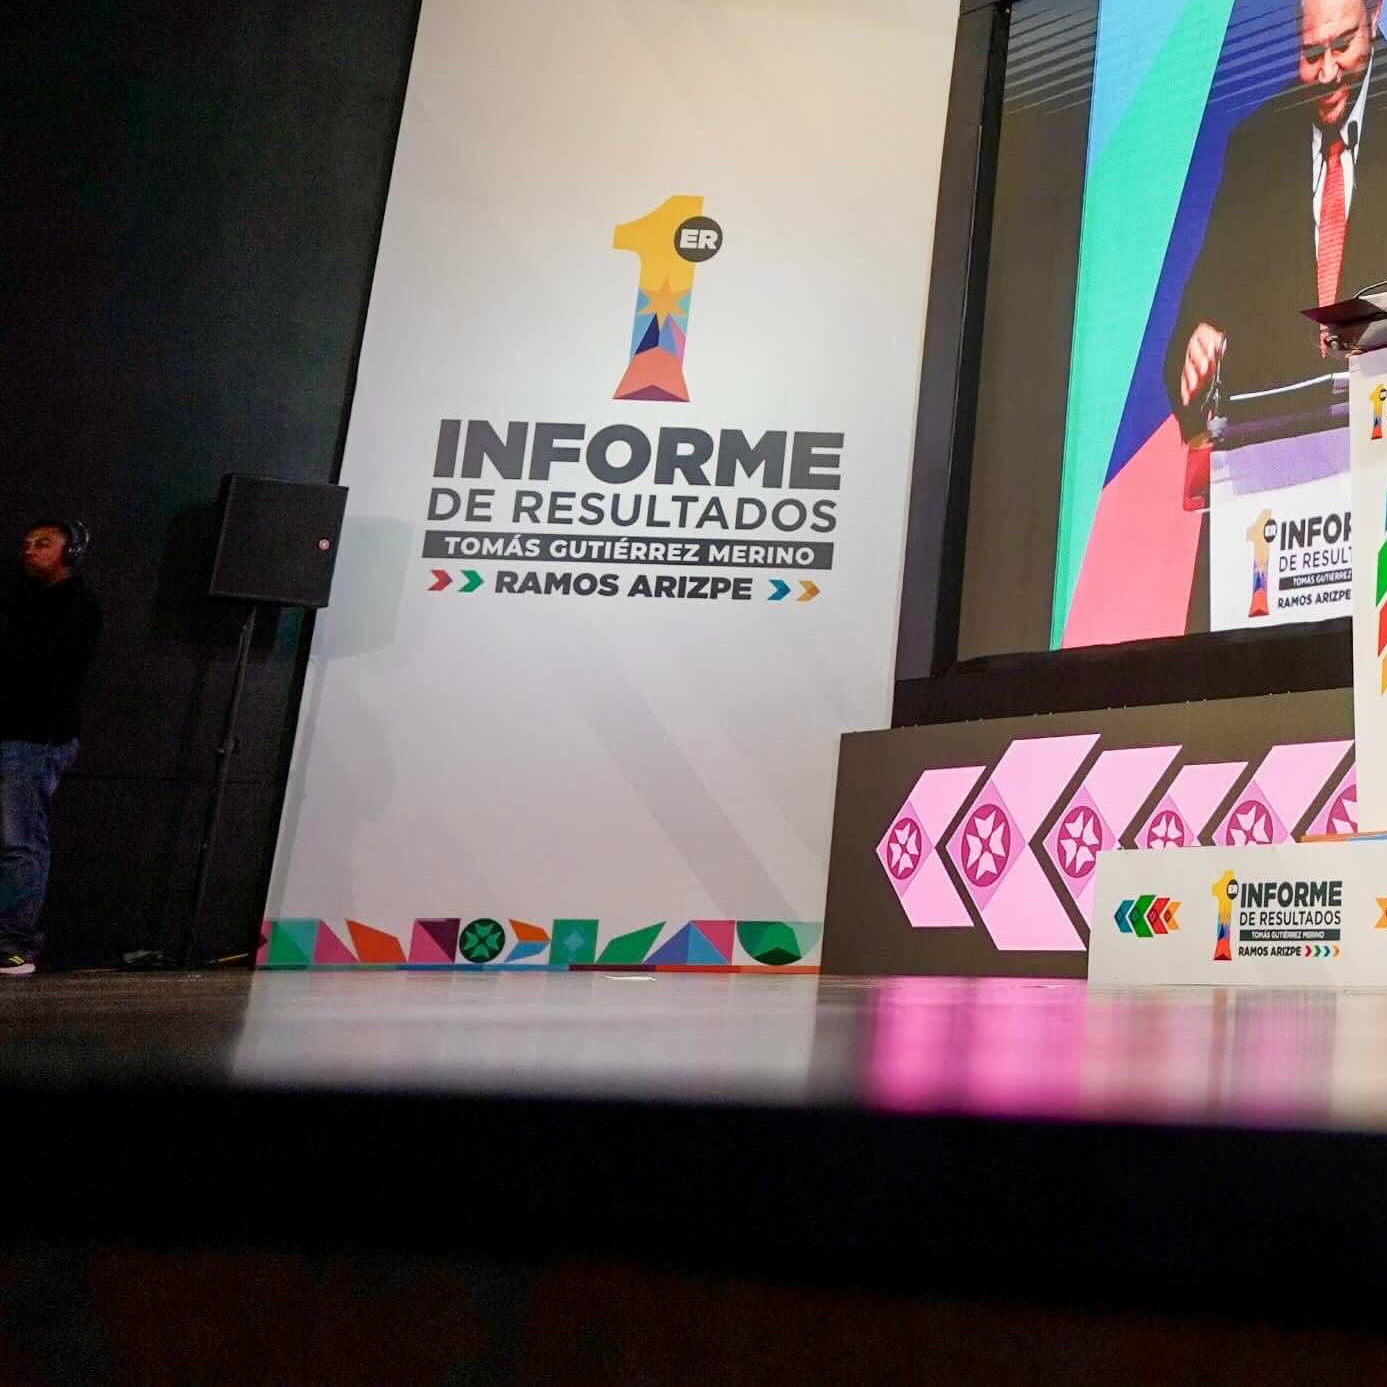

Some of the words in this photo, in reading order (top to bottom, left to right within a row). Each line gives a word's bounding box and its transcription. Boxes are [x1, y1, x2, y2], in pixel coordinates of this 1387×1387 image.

[679, 228, 718, 251] ER
[433, 418, 845, 491] INFORME
[427, 487, 493, 523] DE
[511, 489, 837, 533] RESULTADOS
[444, 534, 541, 558] TOMÁS
[550, 537, 700, 563] GUTIÉRREZ
[708, 543, 816, 566] MERINO
[1279, 554, 1297, 572] DE
[1302, 546, 1352, 570] RESUL
[494, 570, 620, 597] RAMOS
[627, 574, 754, 601] ARIZPE
[1277, 593, 1312, 609] RAMOS
[1314, 588, 1351, 604] ARIZPE
[1240, 880, 1343, 908] INFORME
[1239, 911, 1256, 926] DE
[1260, 910, 1341, 926] RESULTADOS
[1238, 945, 1268, 957] RAMOS
[1269, 945, 1302, 957] ARIZPE
